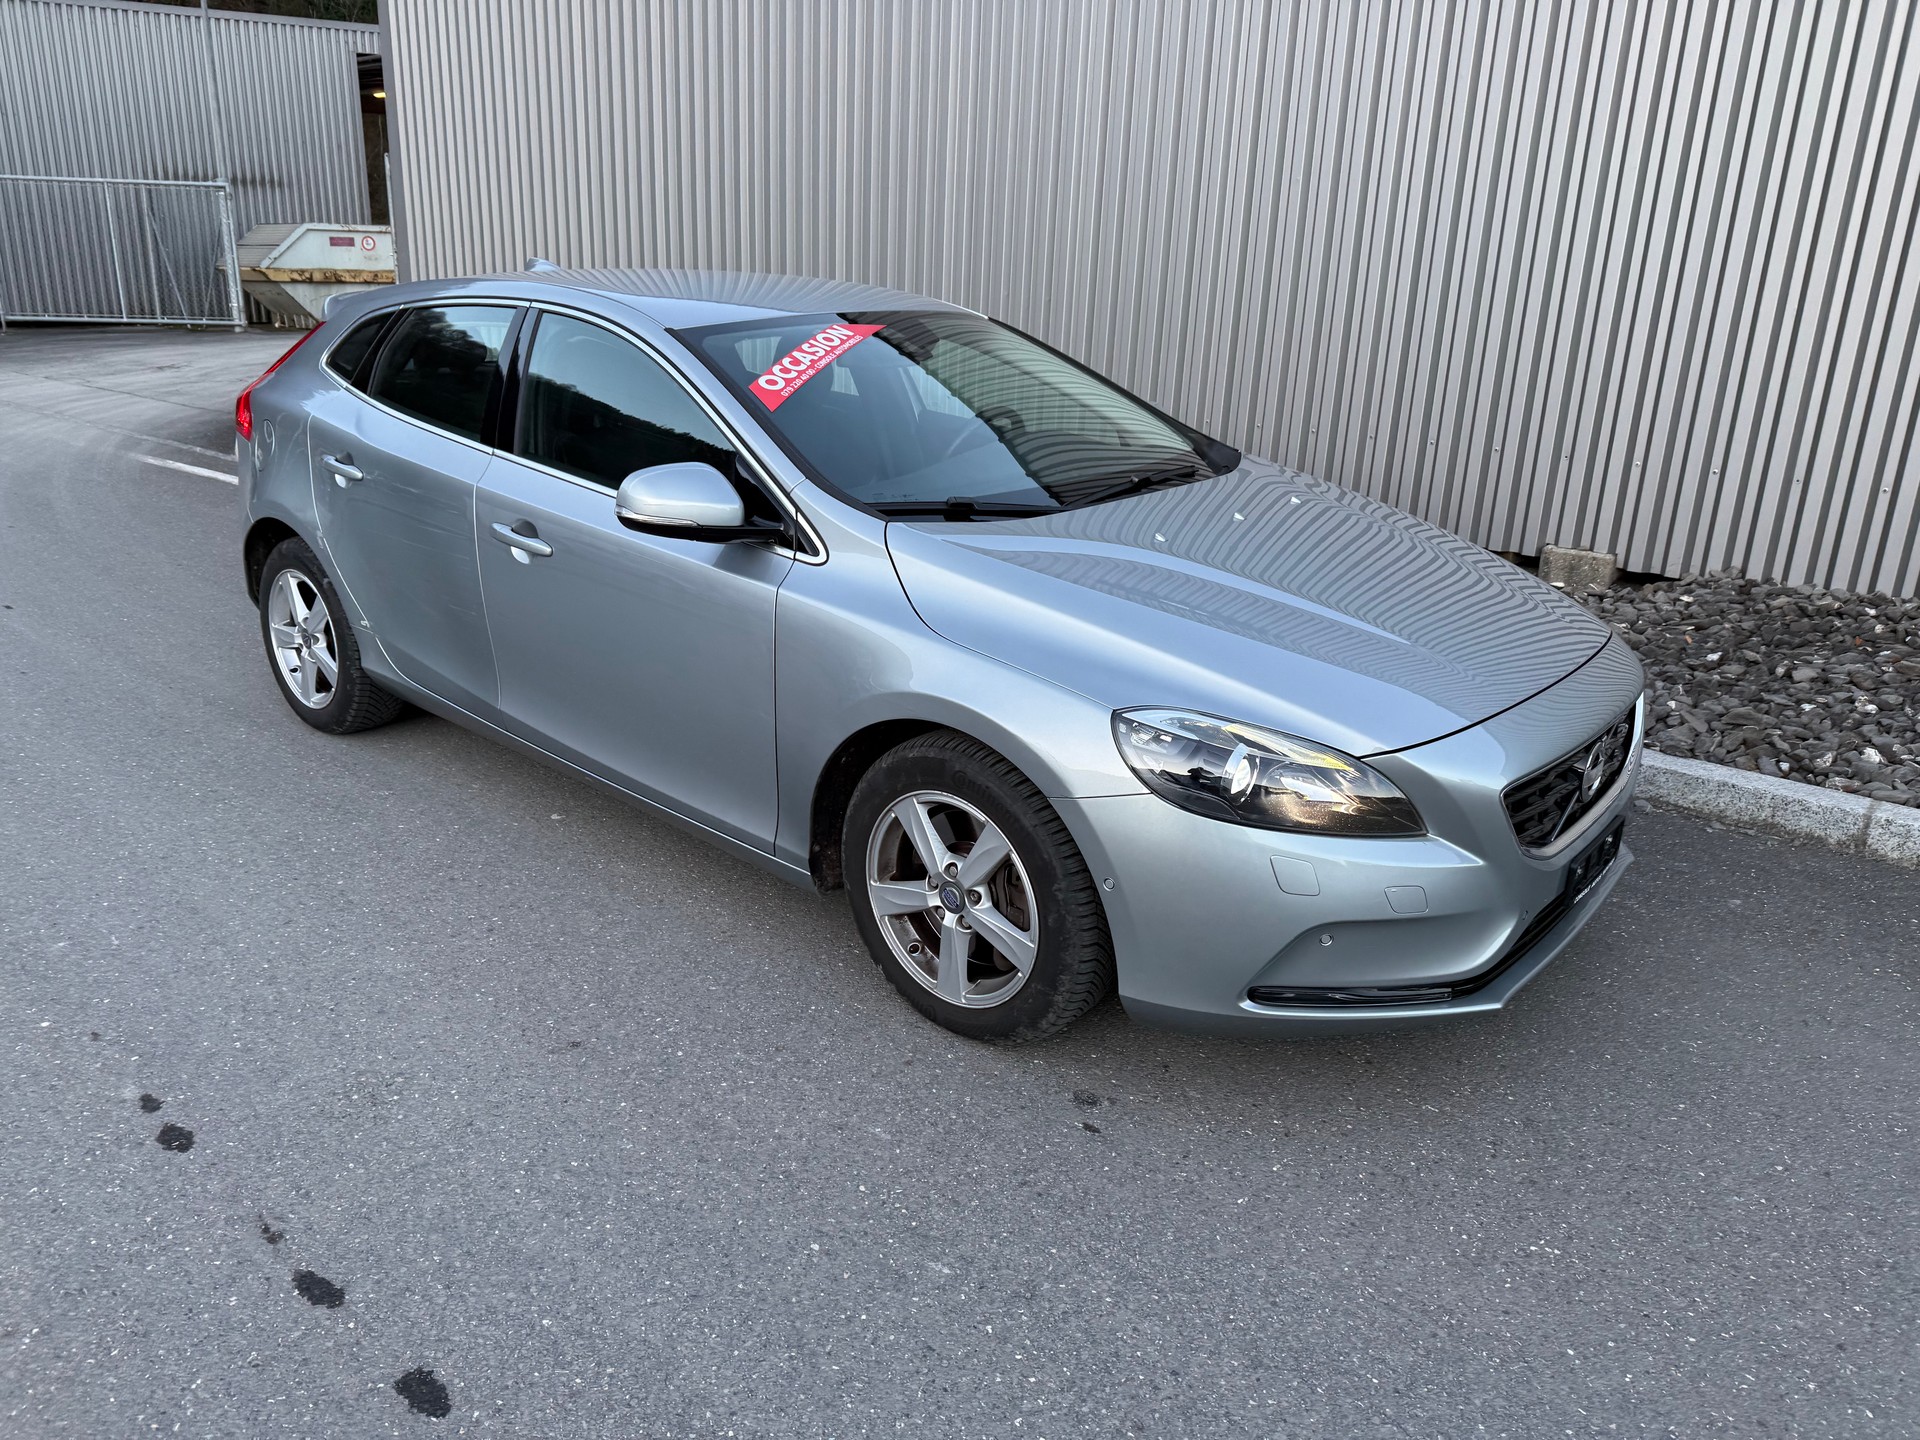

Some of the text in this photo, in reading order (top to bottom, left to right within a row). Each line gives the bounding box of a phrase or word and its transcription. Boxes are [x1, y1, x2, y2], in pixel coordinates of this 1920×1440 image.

[758, 325, 854, 390] OCCASION
[781, 385, 794, 397] 079
[815, 353, 837, 369] CONSOLE
